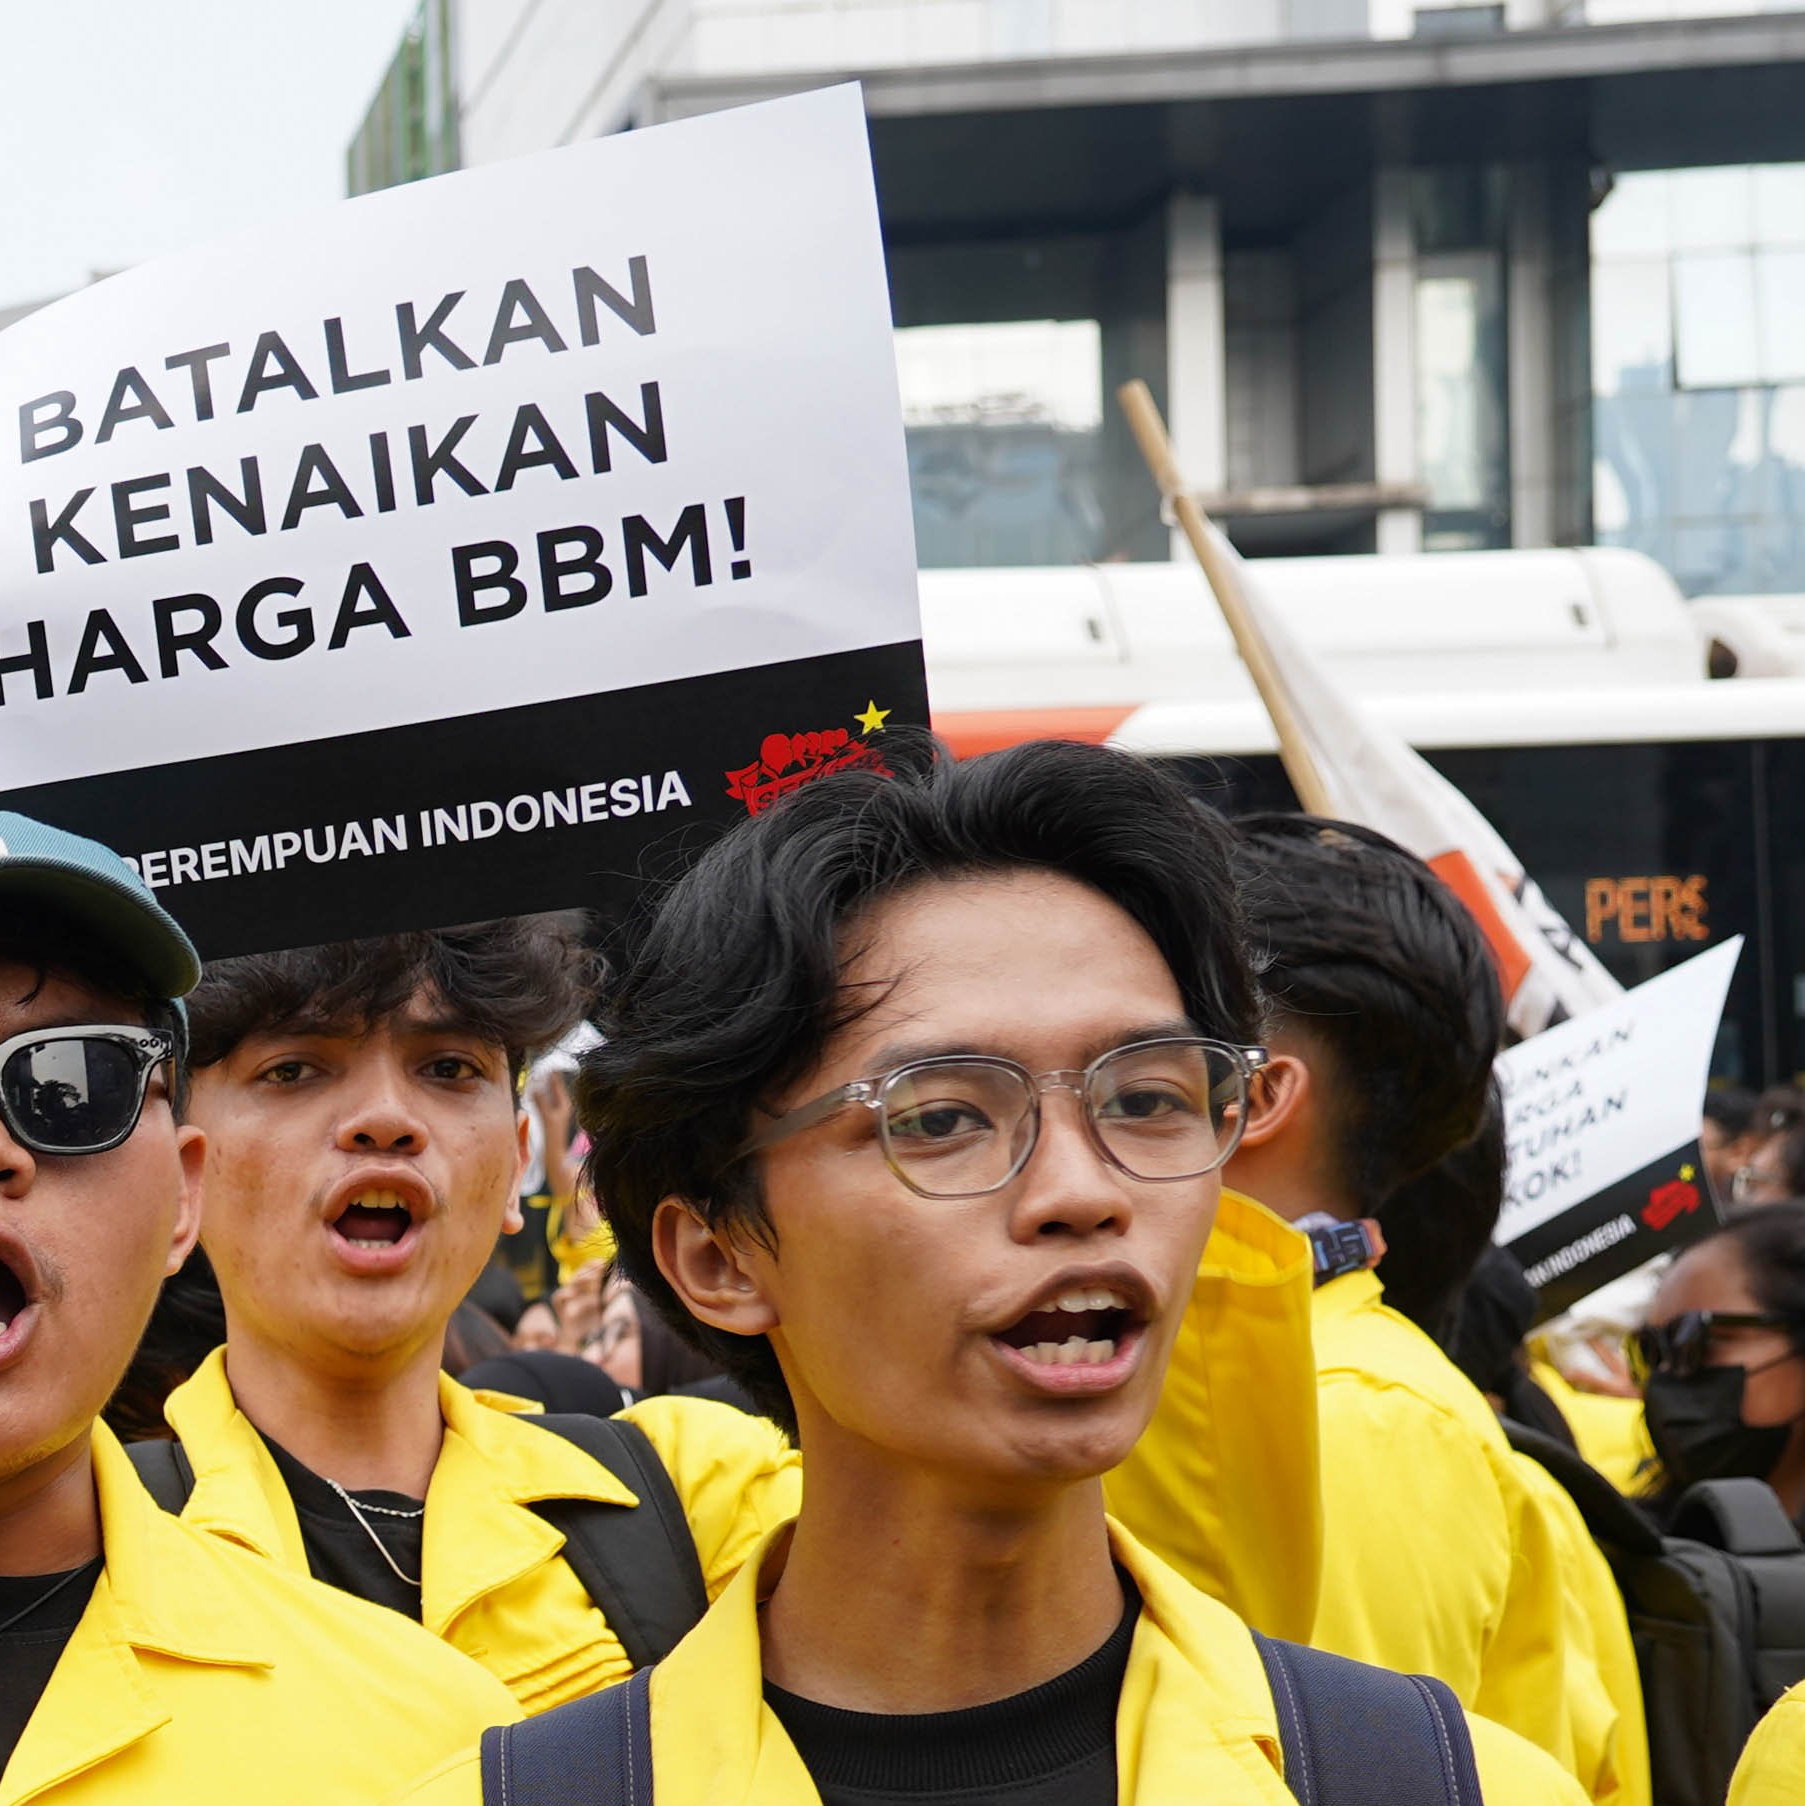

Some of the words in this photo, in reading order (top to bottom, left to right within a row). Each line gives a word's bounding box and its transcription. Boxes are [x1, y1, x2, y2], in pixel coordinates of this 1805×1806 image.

[19, 255, 656, 464] BATALKAN
[30, 381, 667, 574] KENAIKAN
[452, 496, 752, 627] BBM!
[421, 771, 691, 846] INDONESIA
